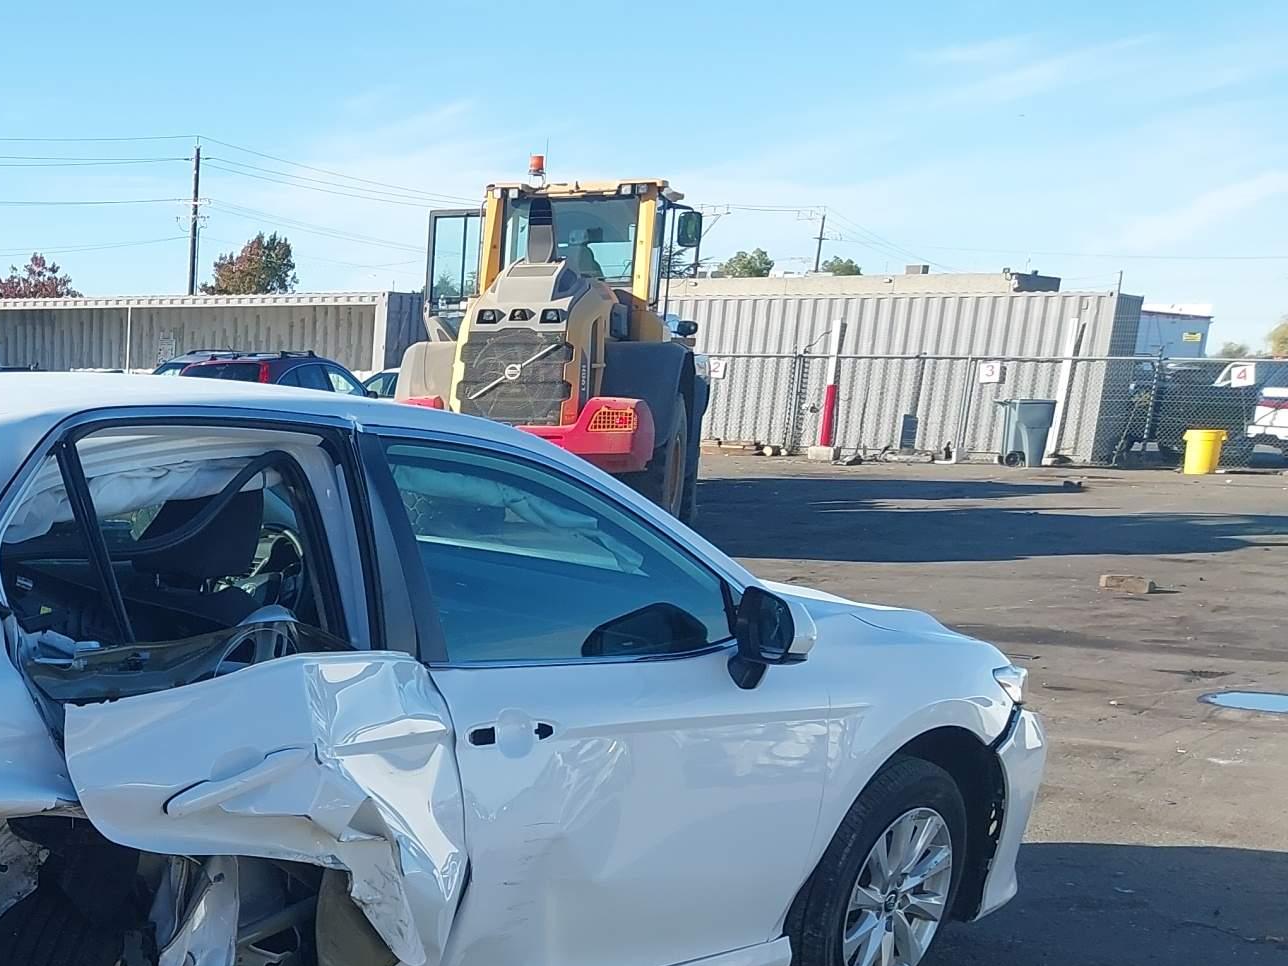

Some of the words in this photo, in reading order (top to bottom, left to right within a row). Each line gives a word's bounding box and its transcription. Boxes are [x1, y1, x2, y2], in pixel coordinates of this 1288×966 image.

[712, 361, 721, 373] 2
[985, 364, 995, 377] 3
[1236, 367, 1247, 381] 4
